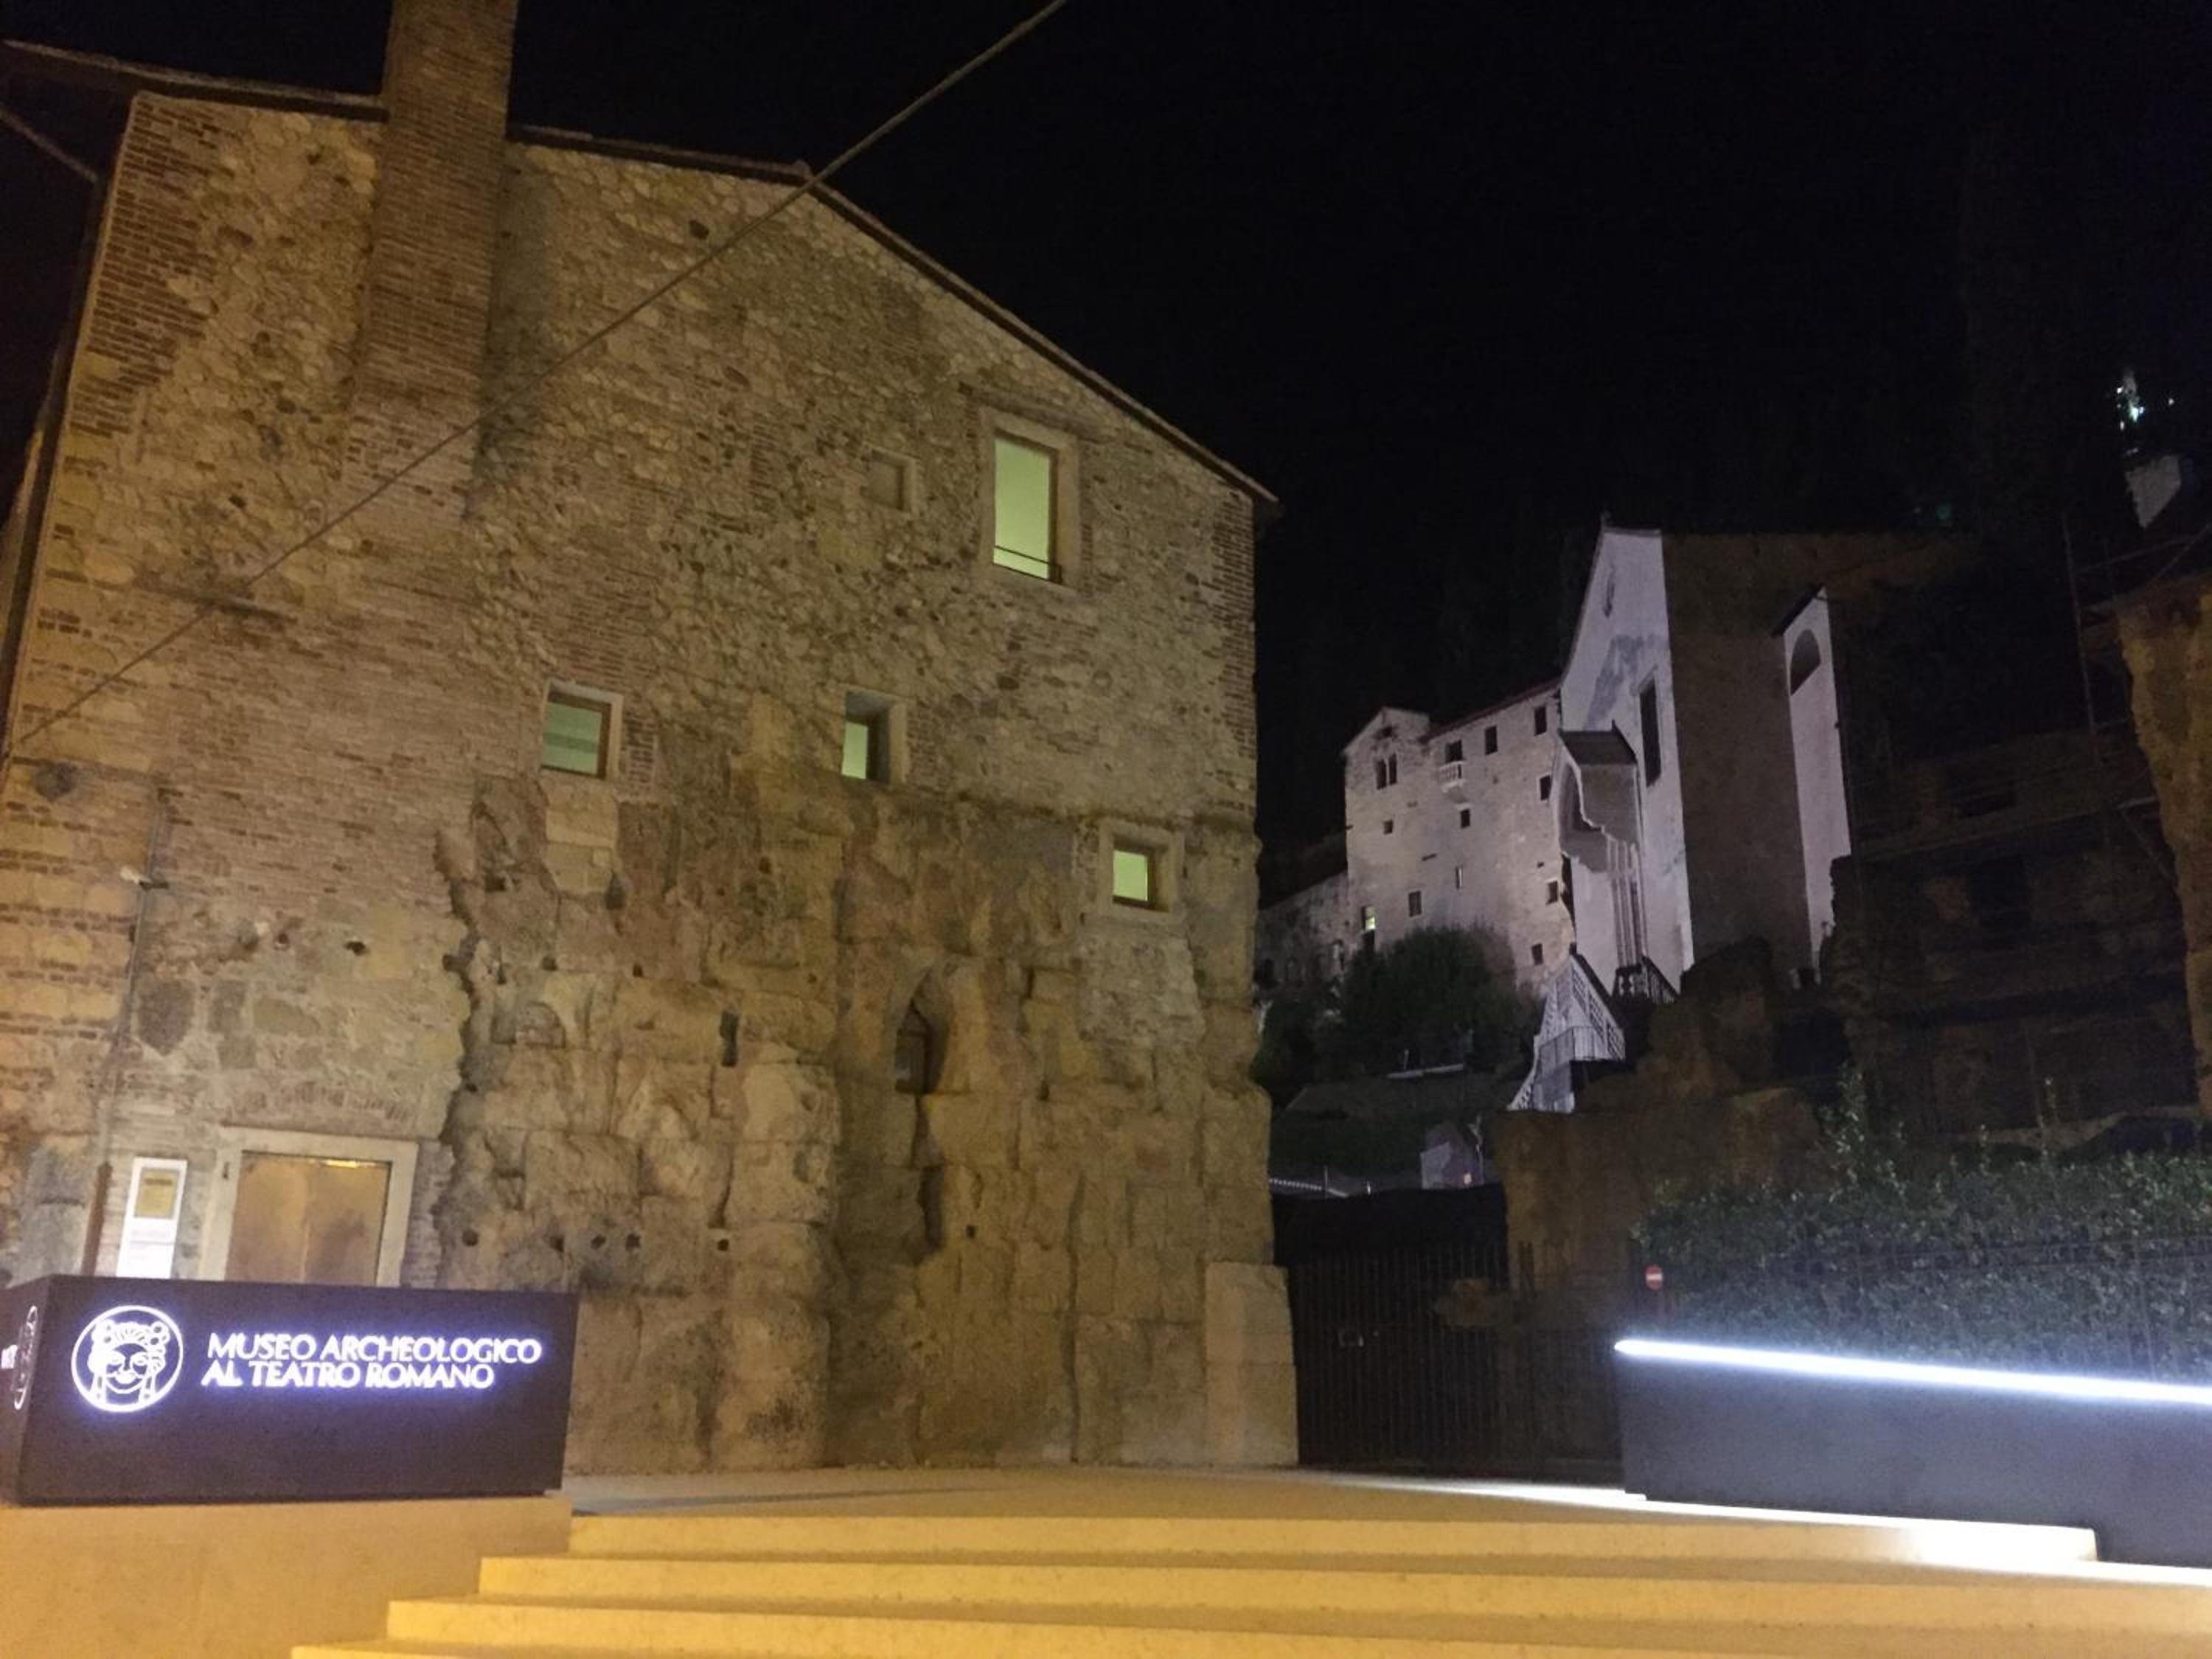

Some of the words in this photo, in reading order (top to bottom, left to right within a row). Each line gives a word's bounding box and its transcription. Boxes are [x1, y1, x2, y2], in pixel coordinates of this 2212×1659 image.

[207, 1333, 316, 1360] MUSEO
[320, 1335, 543, 1364] ARCHEOLOGICO
[201, 1361, 243, 1386] AL
[248, 1361, 361, 1388] TEATRO
[364, 1363, 495, 1389] ROMANO
